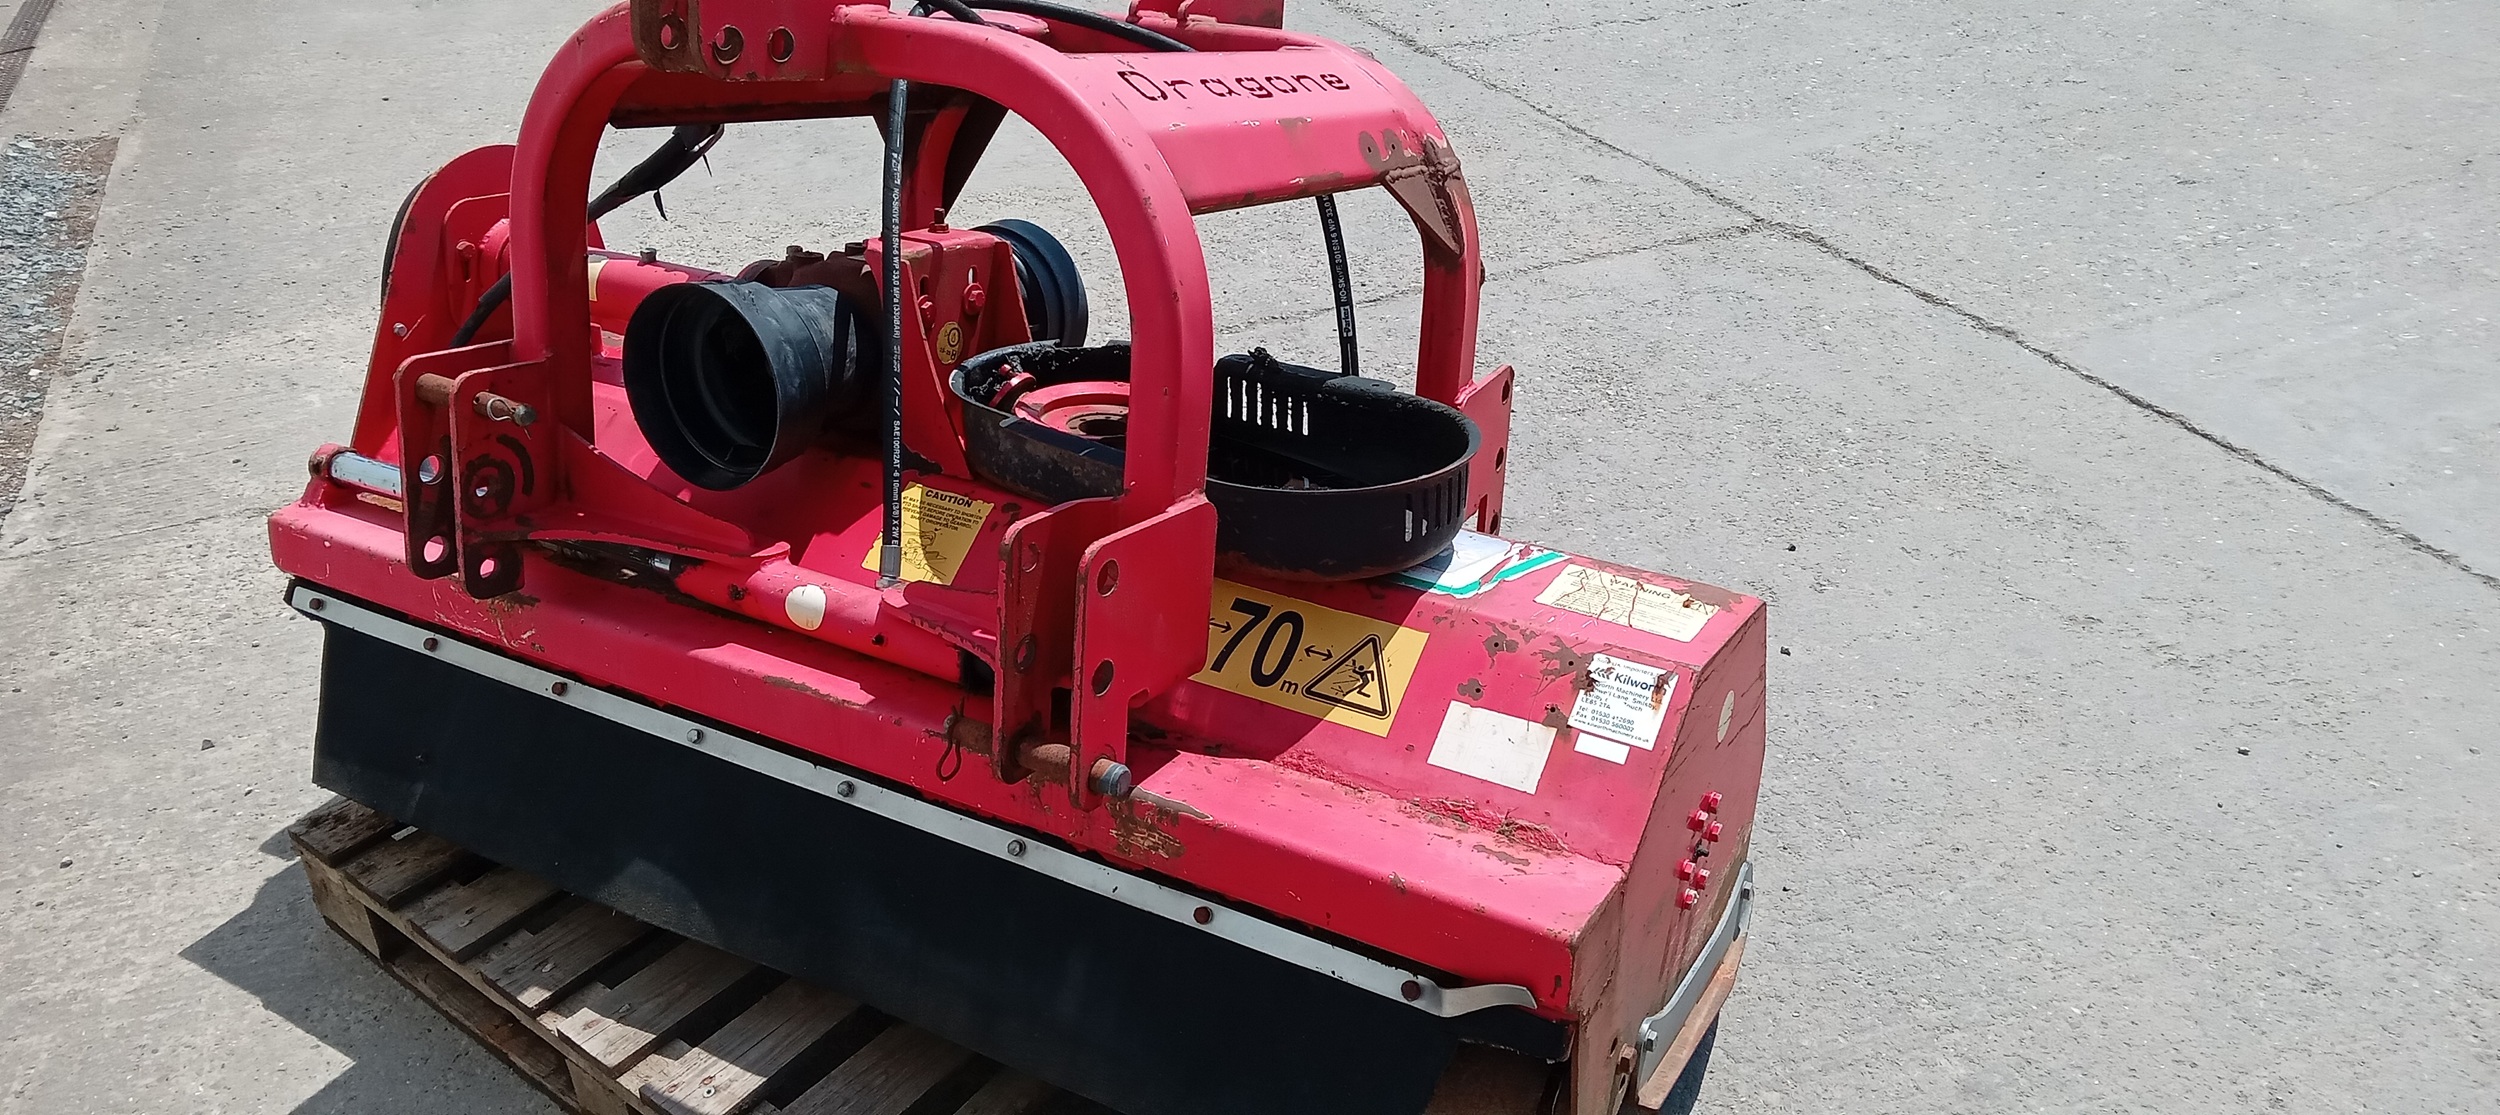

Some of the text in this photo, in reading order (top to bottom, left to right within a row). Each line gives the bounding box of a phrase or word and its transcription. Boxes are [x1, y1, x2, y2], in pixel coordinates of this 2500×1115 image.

[1117, 70, 1350, 102] Dragone
[892, 187, 900, 223] NO-SKIVE
[1327, 219, 1336, 232] WP
[892, 224, 900, 255] 301SN-6
[1330, 233, 1343, 263] 301SN-6
[893, 256, 900, 269] WP
[892, 480, 900, 500] 10mm
[925, 489, 973, 508] CAUTION
[892, 526, 899, 538] 2W
[1610, 578, 1671, 599] WARNING
[1210, 597, 1304, 695] 70 m
[1614, 672, 1667, 697] Kilwor
